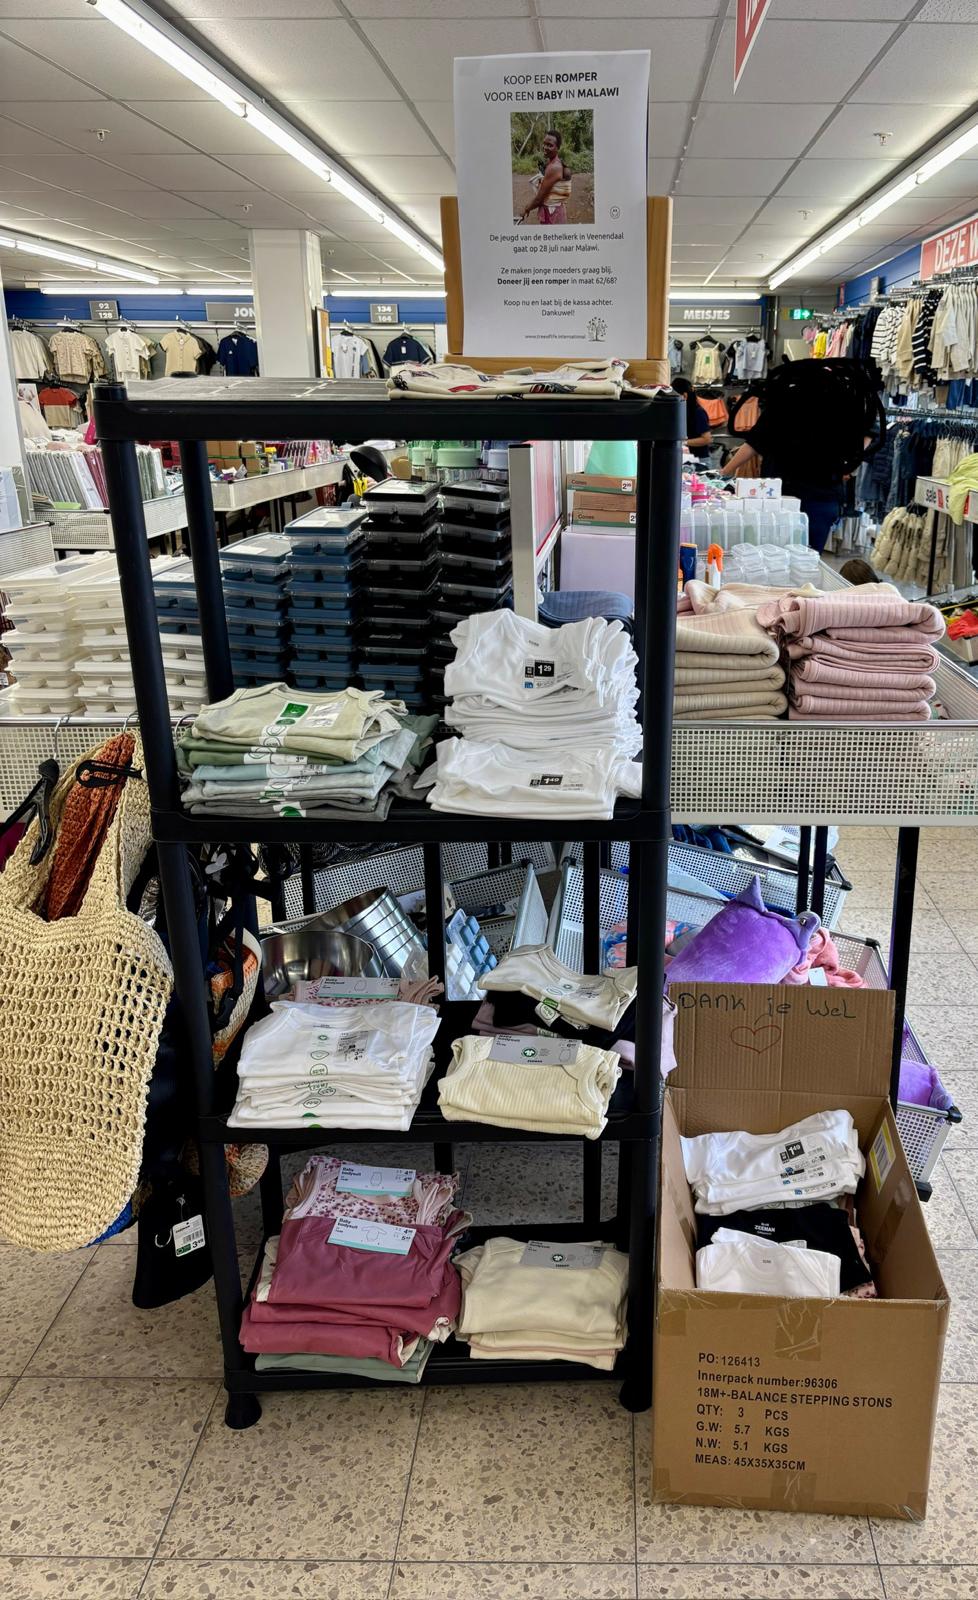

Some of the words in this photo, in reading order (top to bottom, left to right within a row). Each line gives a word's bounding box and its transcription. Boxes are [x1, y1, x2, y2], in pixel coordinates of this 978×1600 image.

[504, 75, 532, 84] KOOP
[534, 74, 553, 84] EEN
[555, 72, 598, 83] ROMPER
[484, 92, 514, 102] VOOR
[516, 91, 534, 101] EEN
[537, 90, 563, 100] BABY
[566, 89, 575, 99] IN
[577, 87, 619, 98] MALAWI
[500, 234, 519, 243] jeugd
[513, 245, 528, 254] gaat
[548, 244, 558, 253] juli
[575, 244, 600, 252] Malawi.
[934, 226, 967, 272] DEZE
[532, 267, 551, 275] jonge
[595, 276, 618, 285] 62/68?
[554, 299, 562, 307] bij
[684, 310, 730, 320] MEISJES
[697, 1370, 754, 1385] Innerpack
[790, 1393, 850, 1407] STEPPING
[852, 1397, 893, 1408] STONS
[696, 1404, 723, 1417] QTY:
[738, 1407, 744, 1418] 3
[765, 1409, 788, 1421] PCS
[696, 1421, 722, 1433] G.W:
[734, 1424, 750, 1435] 5.7
[765, 1426, 790, 1438] KGS
[696, 1438, 721, 1449] N.W:
[732, 1440, 748, 1451] 5.1
[764, 1442, 788, 1454] KGS
[695, 1454, 731, 1466] MEAS:
[734, 1457, 806, 1471] 45X35X35CM
